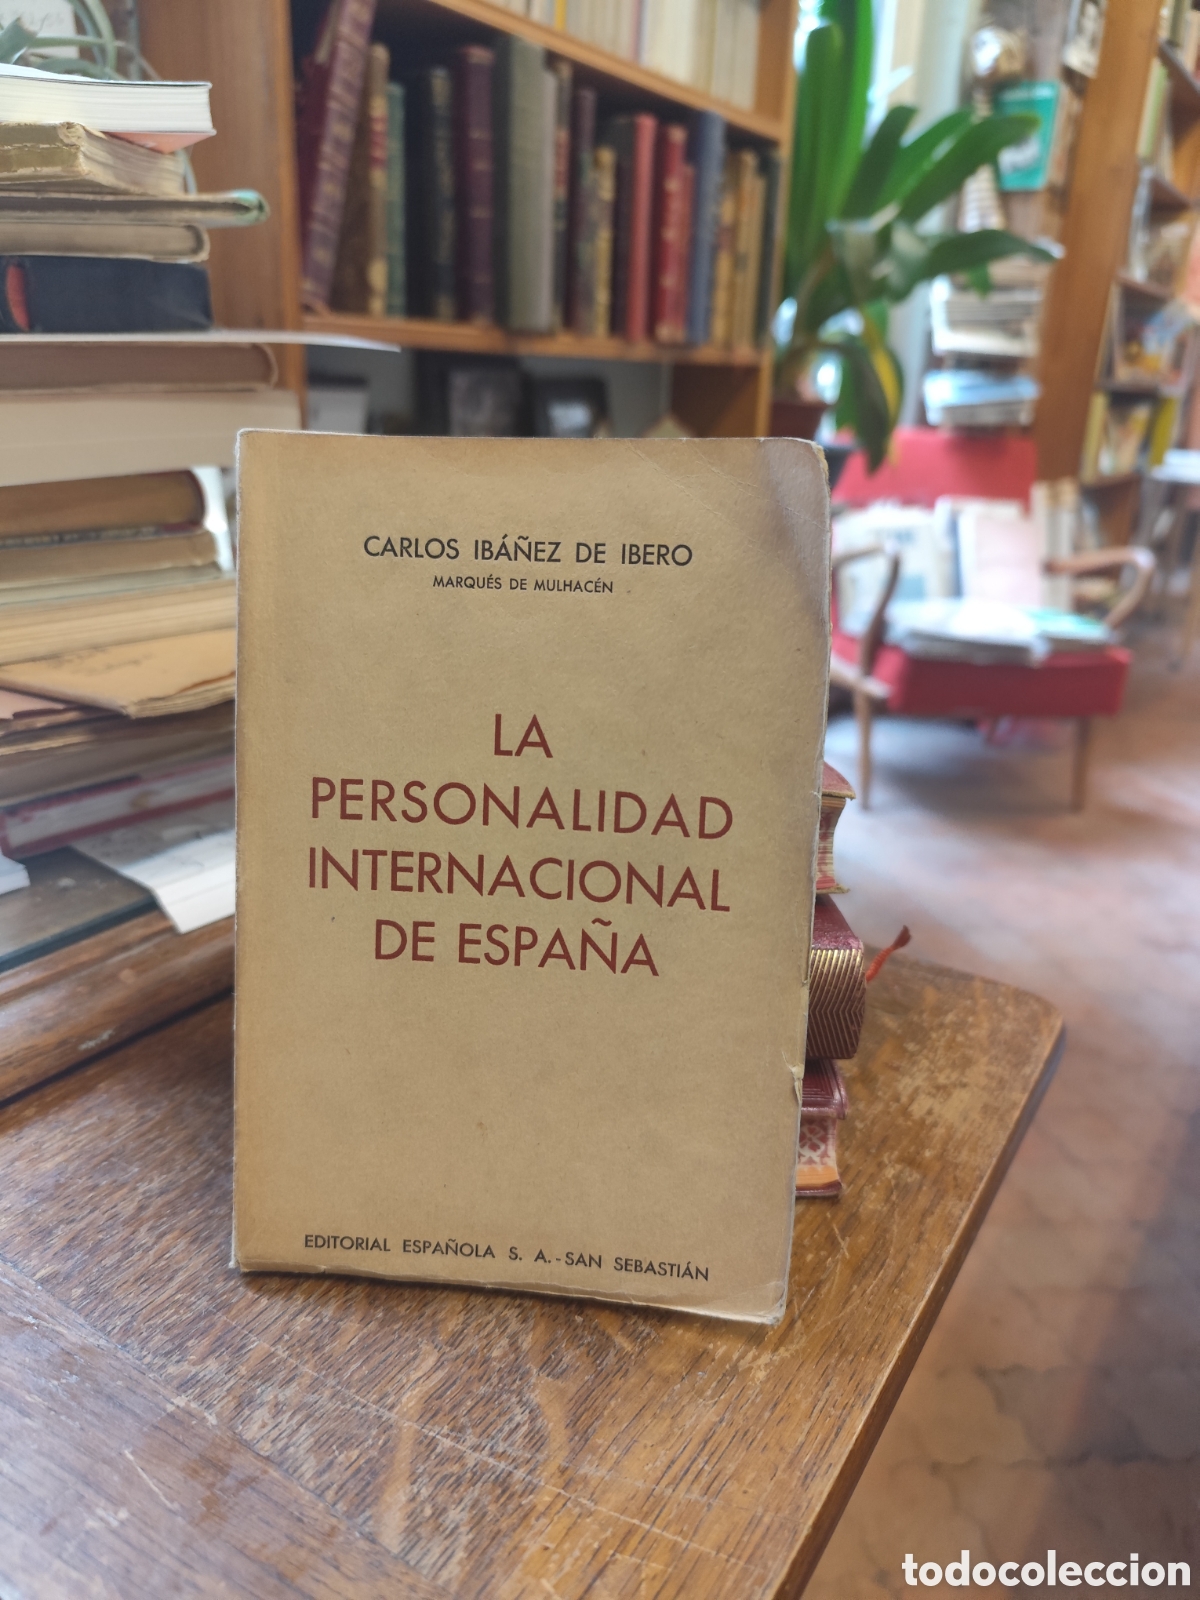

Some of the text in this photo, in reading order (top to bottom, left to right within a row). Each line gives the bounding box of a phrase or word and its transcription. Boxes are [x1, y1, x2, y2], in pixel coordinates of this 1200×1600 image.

[363, 533, 693, 567] CARLOS IBÁÑEZ DE IBERO
[432, 573, 614, 594] MARQUÉS DE MULHACÉN
[493, 713, 554, 759] LA
[311, 776, 733, 840] PERSONALIDAD
[308, 845, 731, 913] INTERNACIONAL
[374, 917, 660, 977] DE ESPAÑA
[304, 1234, 391, 1252] EDITORIAL
[402, 1238, 496, 1259] ESPAÑOLA
[613, 1256, 709, 1282] SEBASTIÁN
